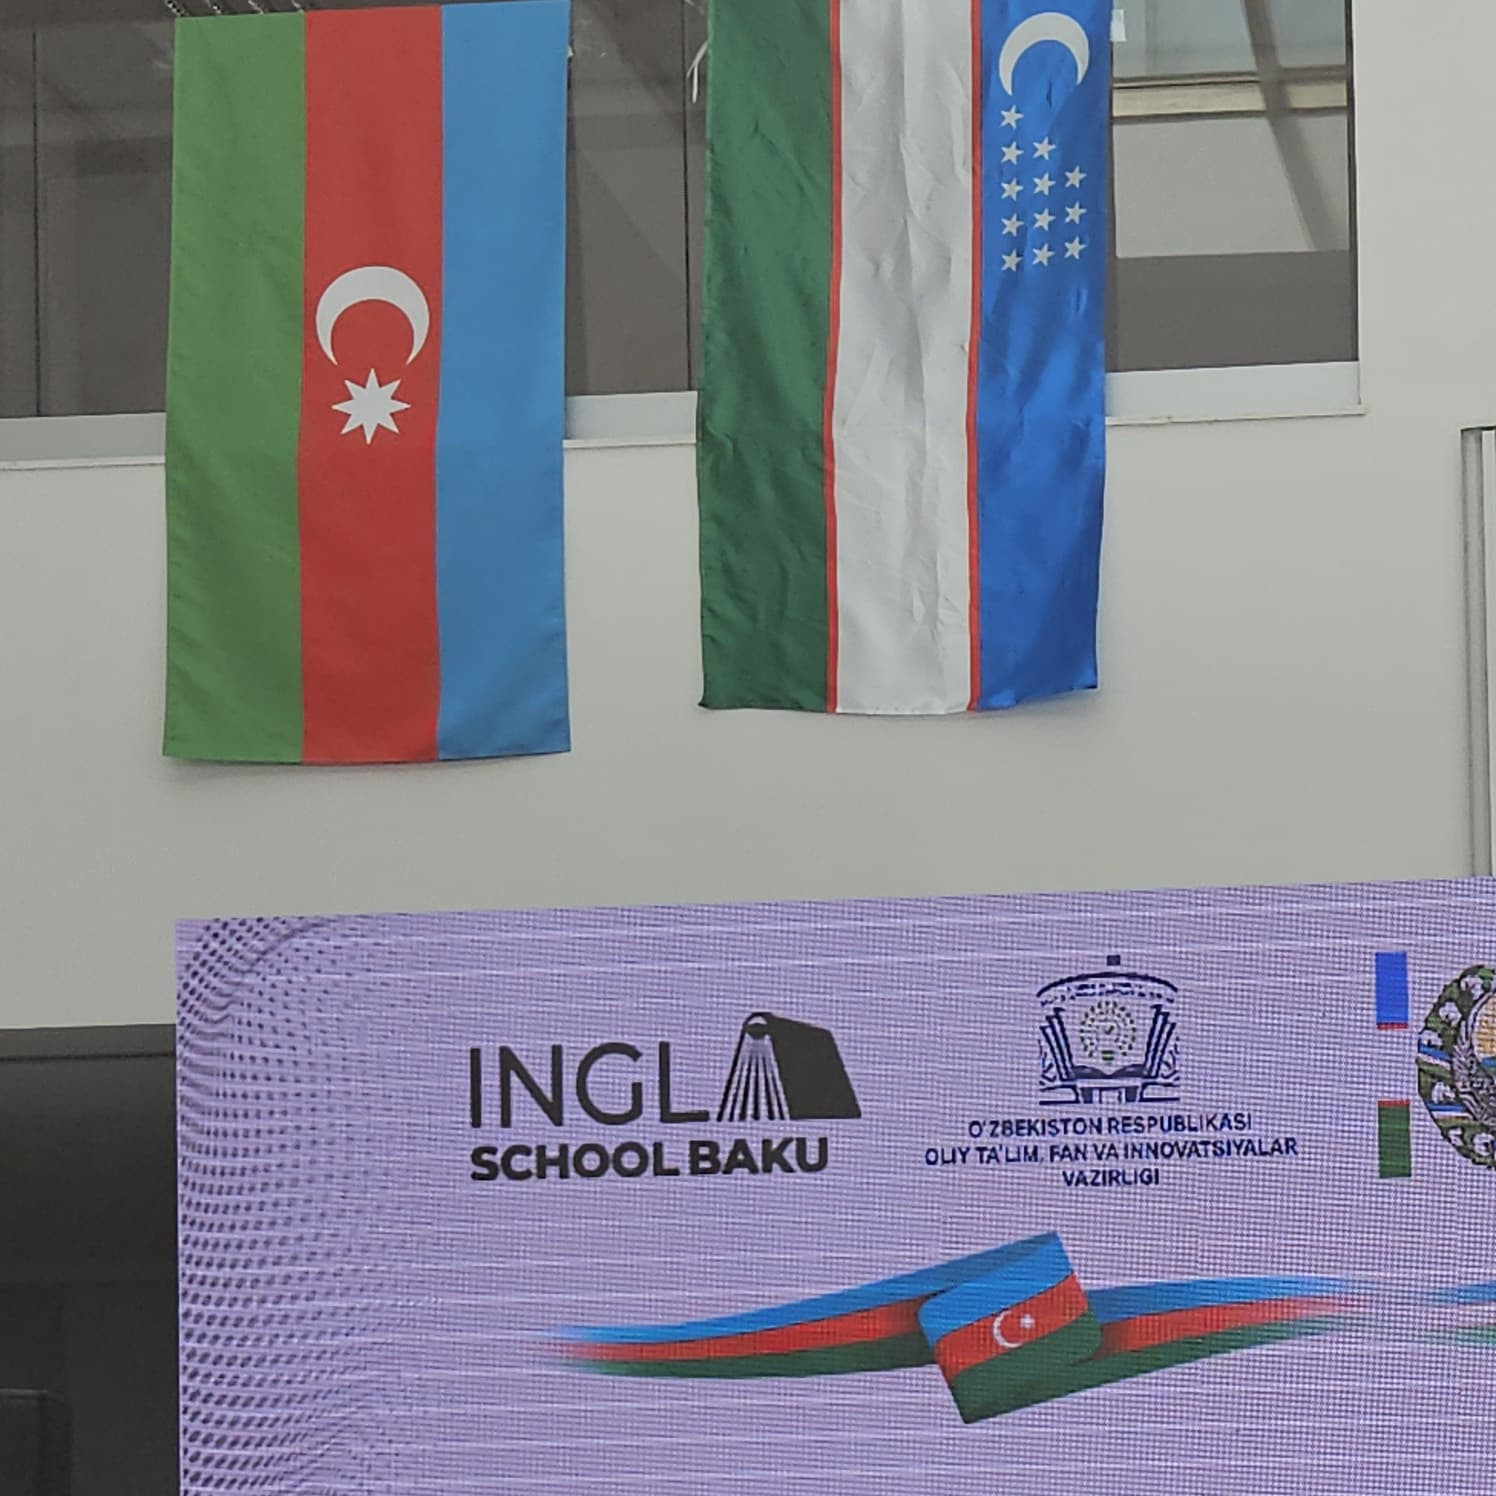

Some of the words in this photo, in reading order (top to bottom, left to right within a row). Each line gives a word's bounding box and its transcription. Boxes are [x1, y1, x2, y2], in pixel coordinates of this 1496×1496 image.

[1107, 1113, 1252, 1134] RESPUBLIKASI
[470, 1141, 680, 1181] SCHOOL
[689, 1136, 829, 1176] BAKU
[925, 1147, 971, 1166] OLIY
[1049, 1144, 1091, 1163] FAN
[1091, 1143, 1121, 1162] VA
[1123, 1137, 1299, 1161] INNOVATSIYALAR
[1062, 1167, 1160, 1188] VAZIRLIGI
